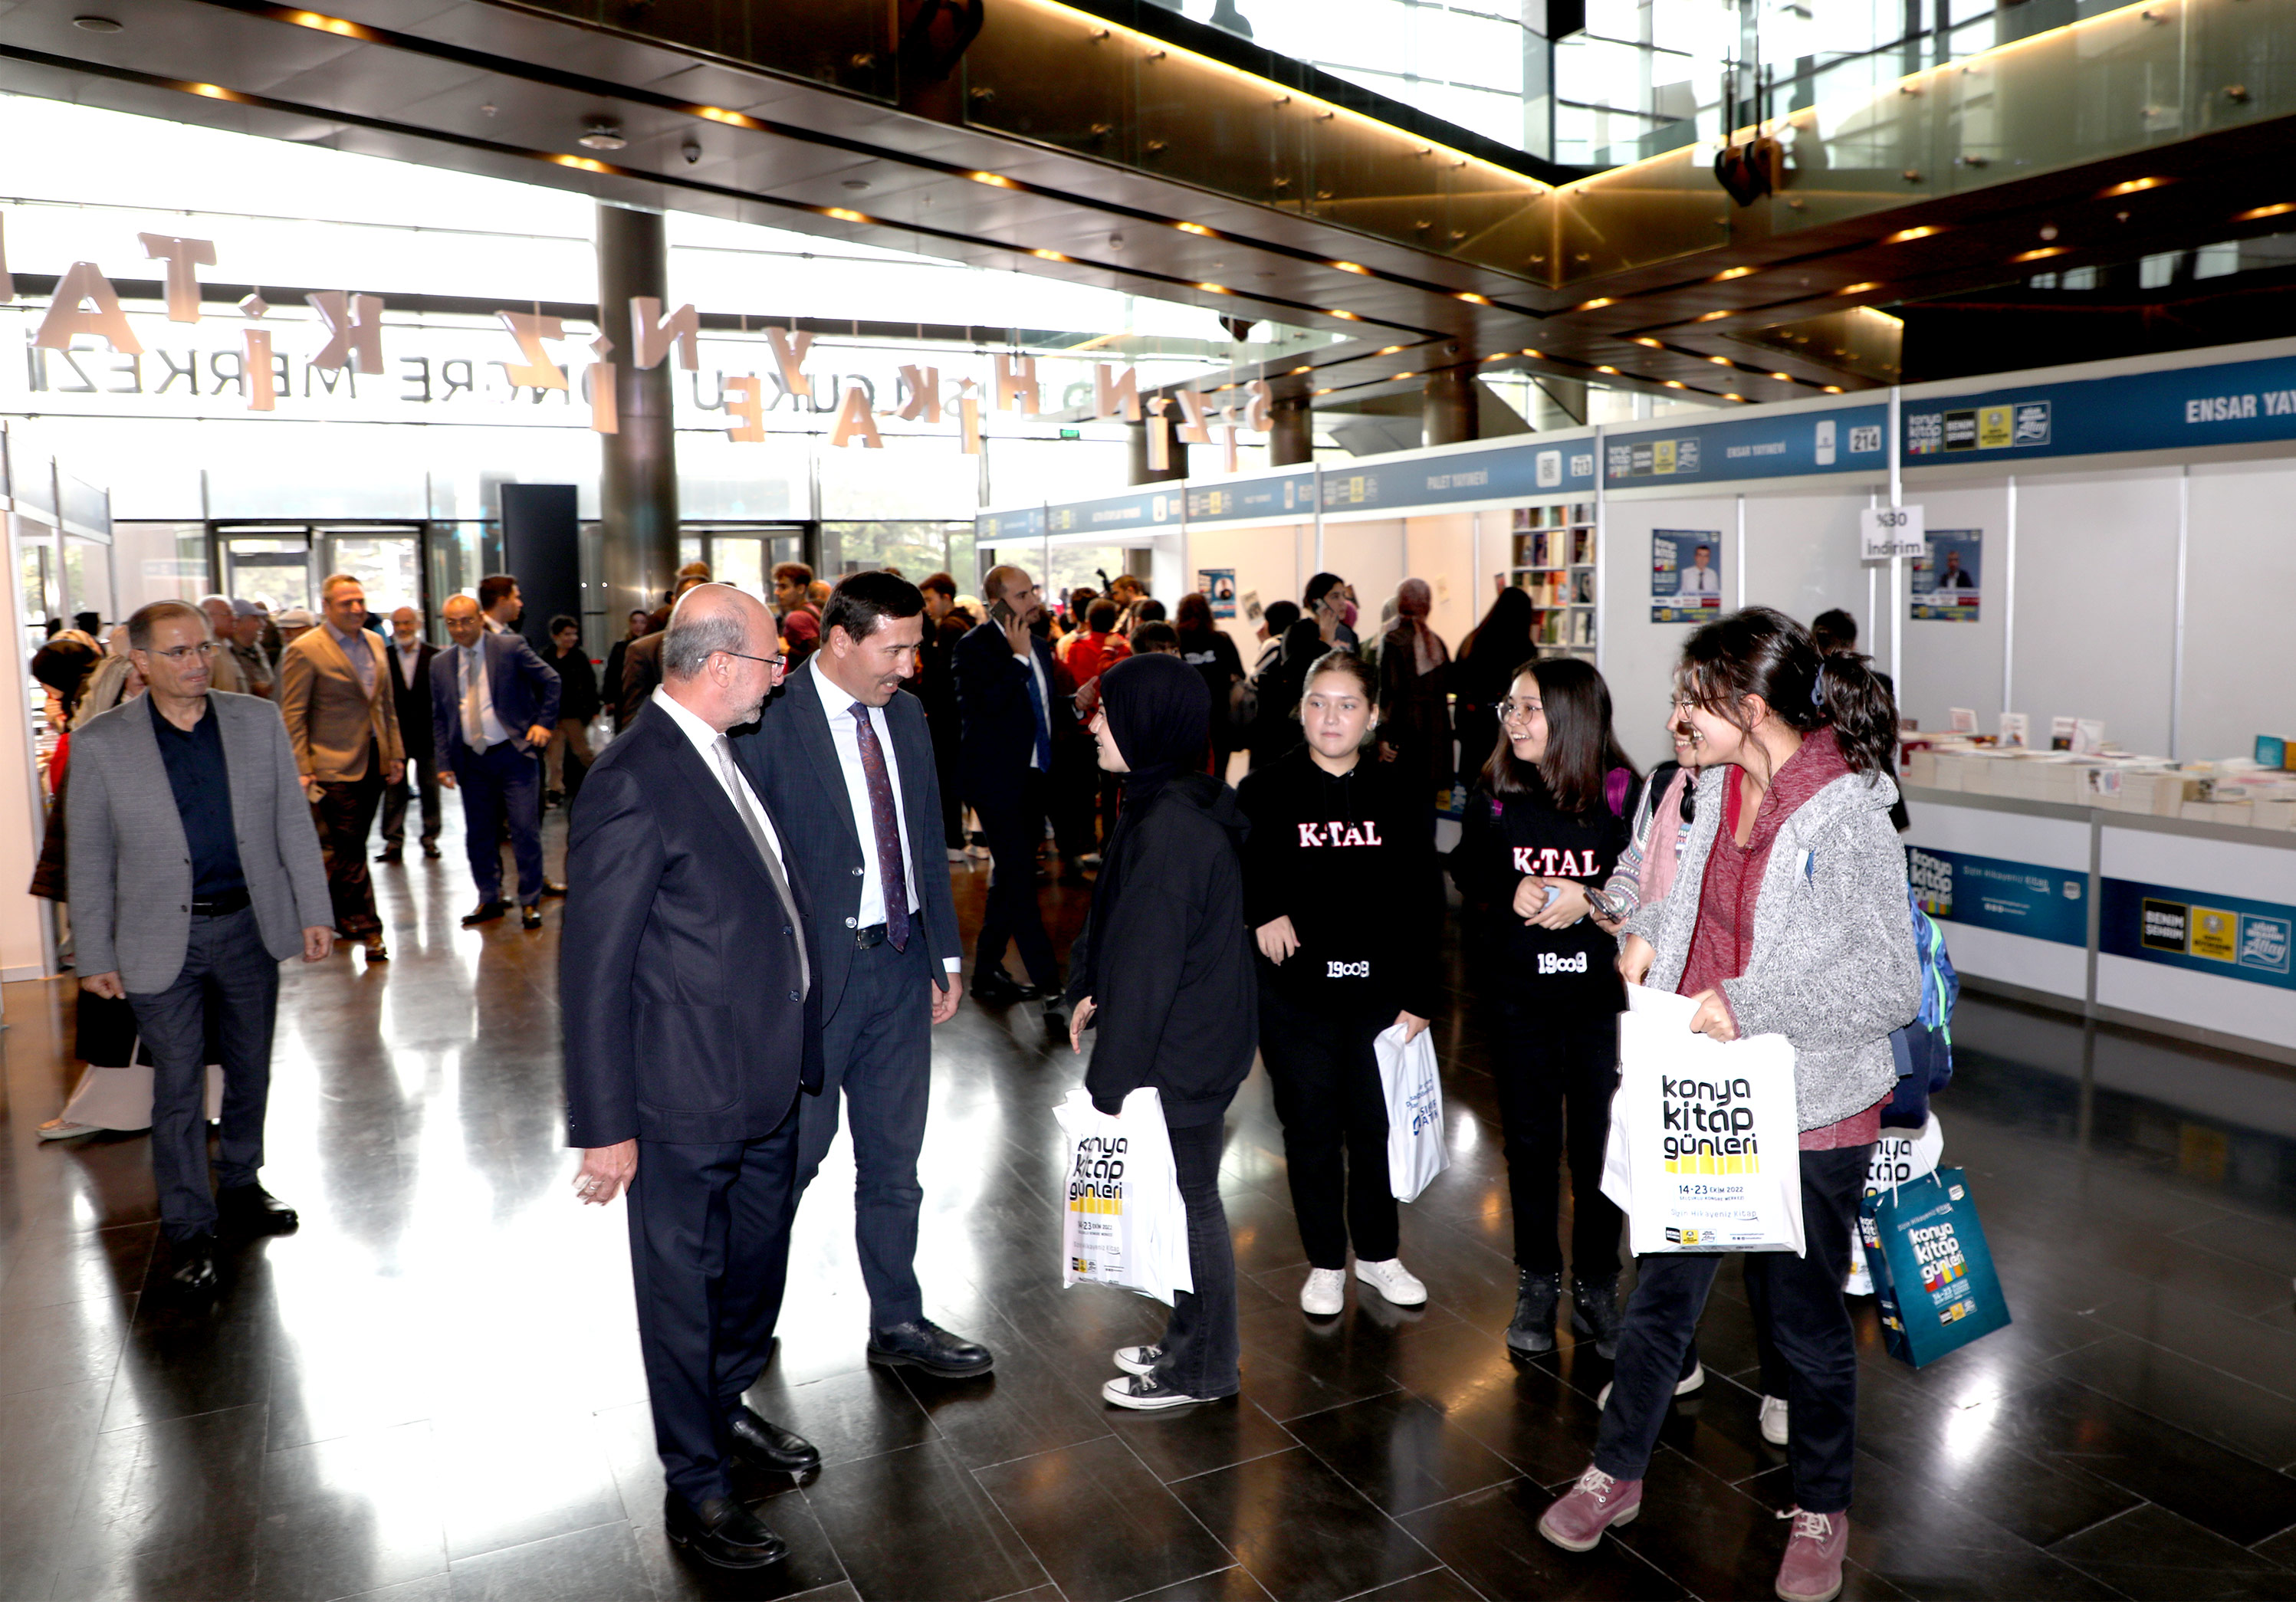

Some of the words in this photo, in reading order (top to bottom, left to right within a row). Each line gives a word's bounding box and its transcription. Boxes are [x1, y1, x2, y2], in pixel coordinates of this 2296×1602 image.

[2186, 393, 2258, 423] ENSAR
[1854, 433, 1878, 451] 214
[1876, 512, 1908, 527] %30
[1867, 539, 1921, 556] İndirim
[1662, 1075, 1751, 1108] konya
[1664, 1101, 1754, 1136] kitap
[1664, 1133, 1758, 1160] günleri
[1069, 1180, 1122, 1200] günleri
[1908, 1223, 1954, 1246] konya
[1913, 1237, 1959, 1266] kitap
[1920, 1250, 1965, 1284] günleri
